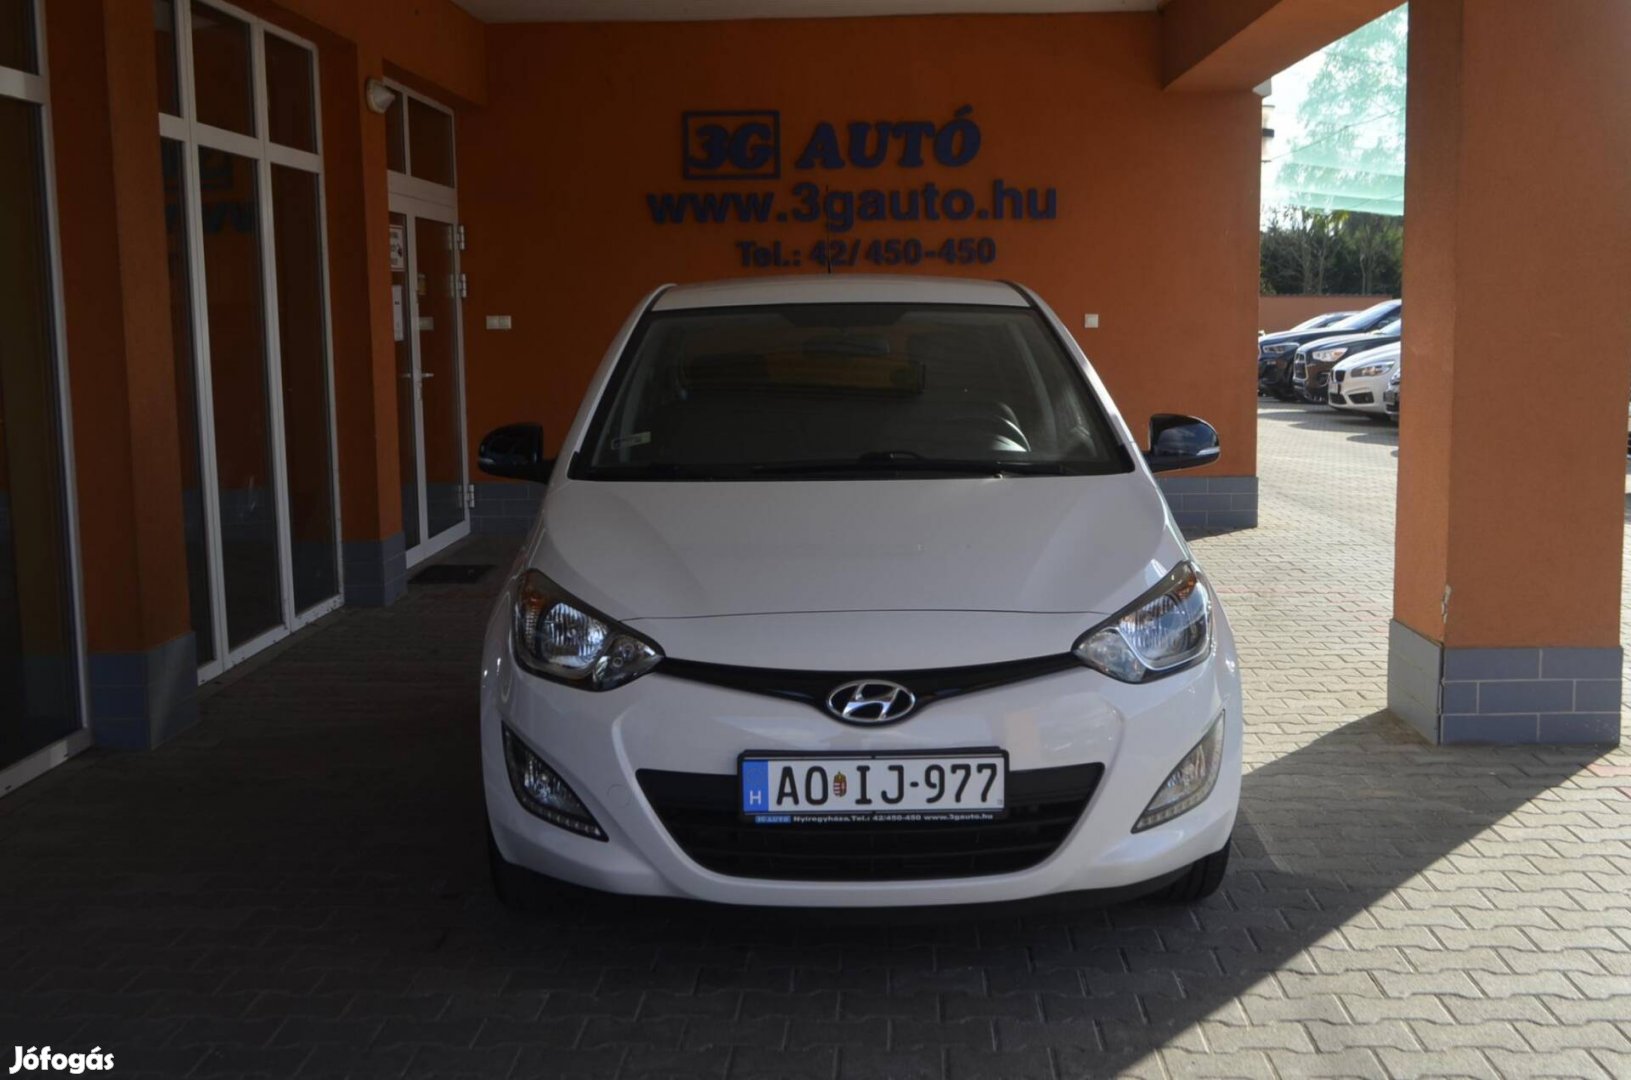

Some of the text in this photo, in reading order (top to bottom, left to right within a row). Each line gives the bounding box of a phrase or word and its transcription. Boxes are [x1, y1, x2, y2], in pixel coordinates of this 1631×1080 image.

[686, 104, 982, 171] 3G AUTÓ
[646, 179, 1057, 232] www.3gauto.hu
[735, 240, 803, 268] Tel.:
[749, 790, 762, 805] H
